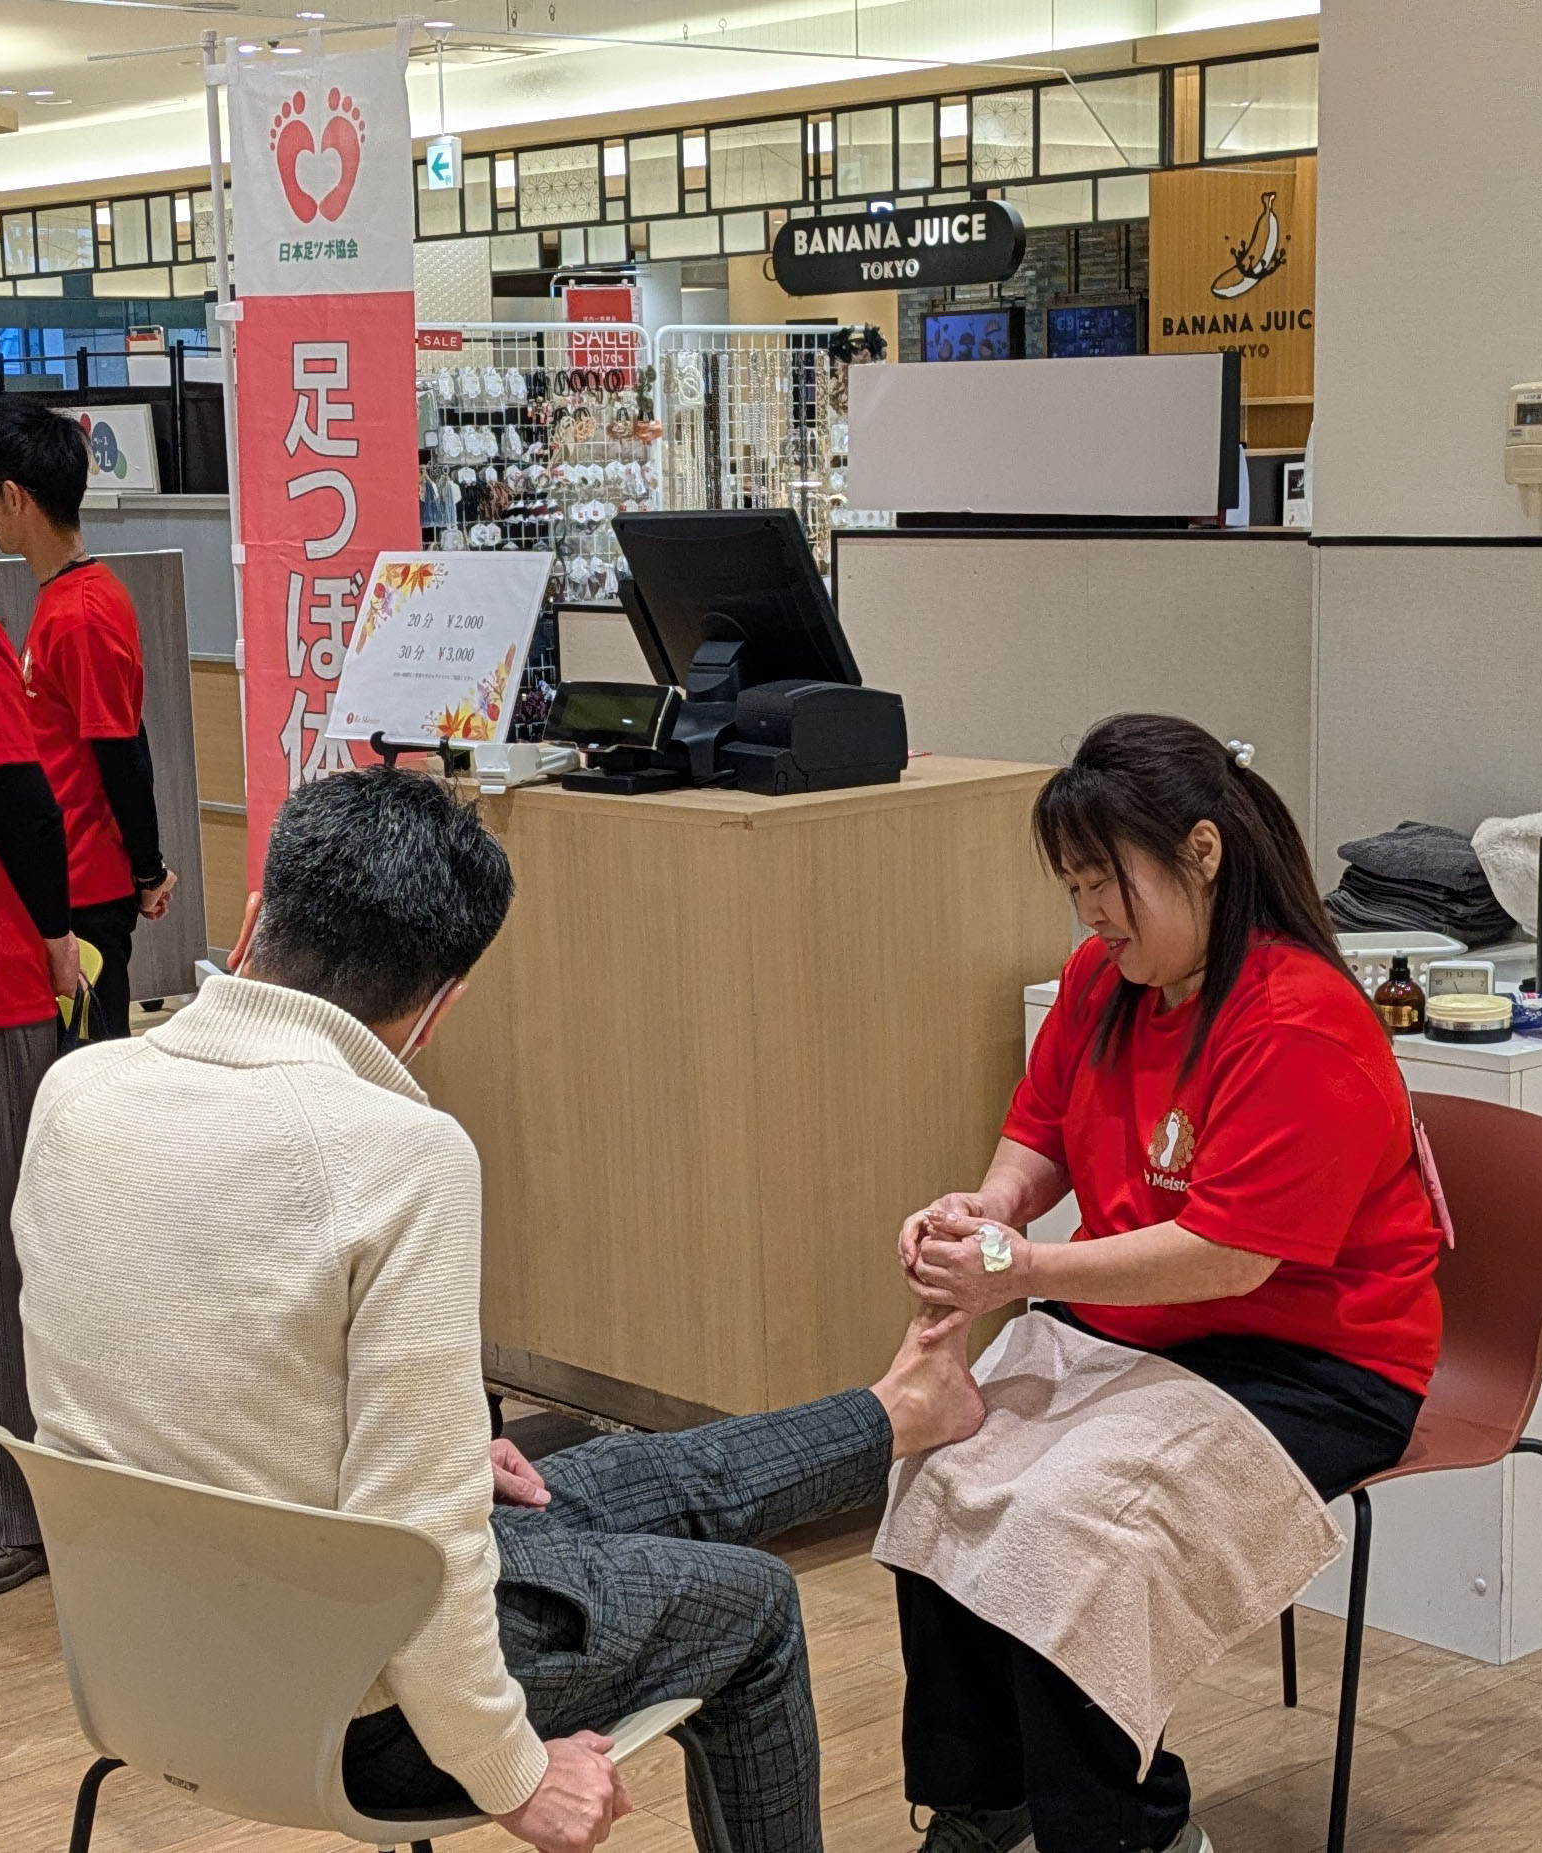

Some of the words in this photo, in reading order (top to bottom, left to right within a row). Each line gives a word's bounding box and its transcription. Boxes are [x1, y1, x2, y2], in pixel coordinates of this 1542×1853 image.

[794, 222, 901, 256] BANANA
[907, 213, 987, 248] JUICE
[279, 238, 358, 262] 日本足ツボ協会
[861, 258, 920, 280] TOKYO
[1162, 313, 1253, 336] BANANA
[1260, 309, 1313, 331] JUIC
[423, 336, 458, 347] SALE
[573, 330, 630, 345] SALE
[447, 614, 484, 630] ¥2,000
[438, 646, 475, 662] ¥3,000
[1152, 1172, 1189, 1192] Meist
